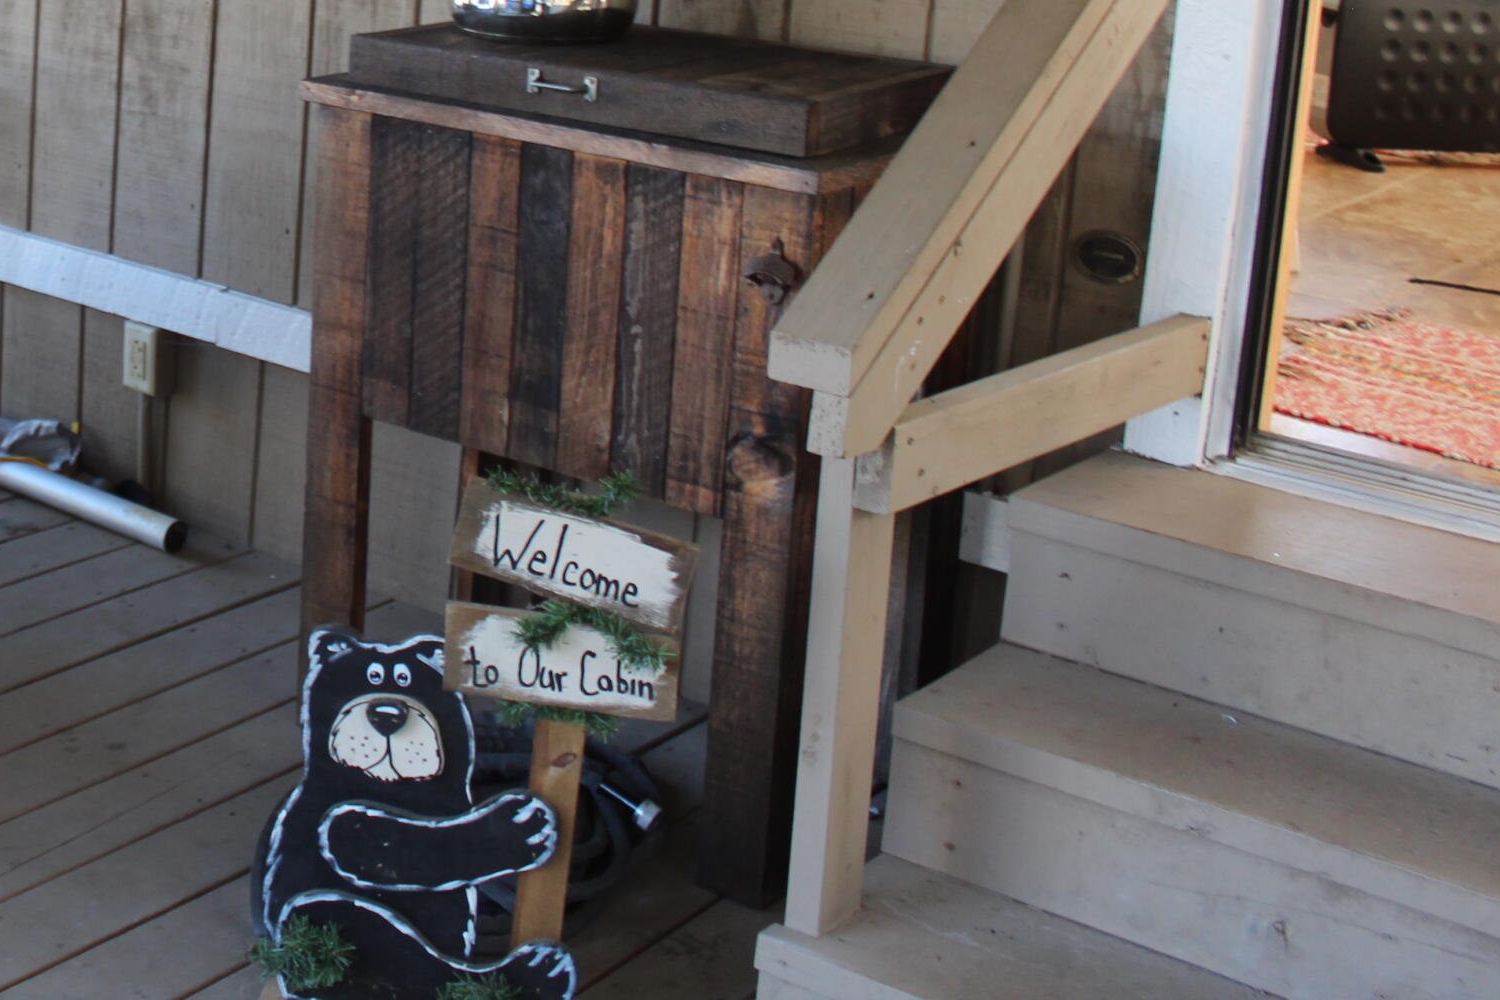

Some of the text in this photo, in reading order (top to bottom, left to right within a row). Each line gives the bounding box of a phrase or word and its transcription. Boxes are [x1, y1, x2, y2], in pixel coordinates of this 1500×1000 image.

[493, 514, 639, 608] Welcome
[464, 645, 654, 701] to Our Cabin
